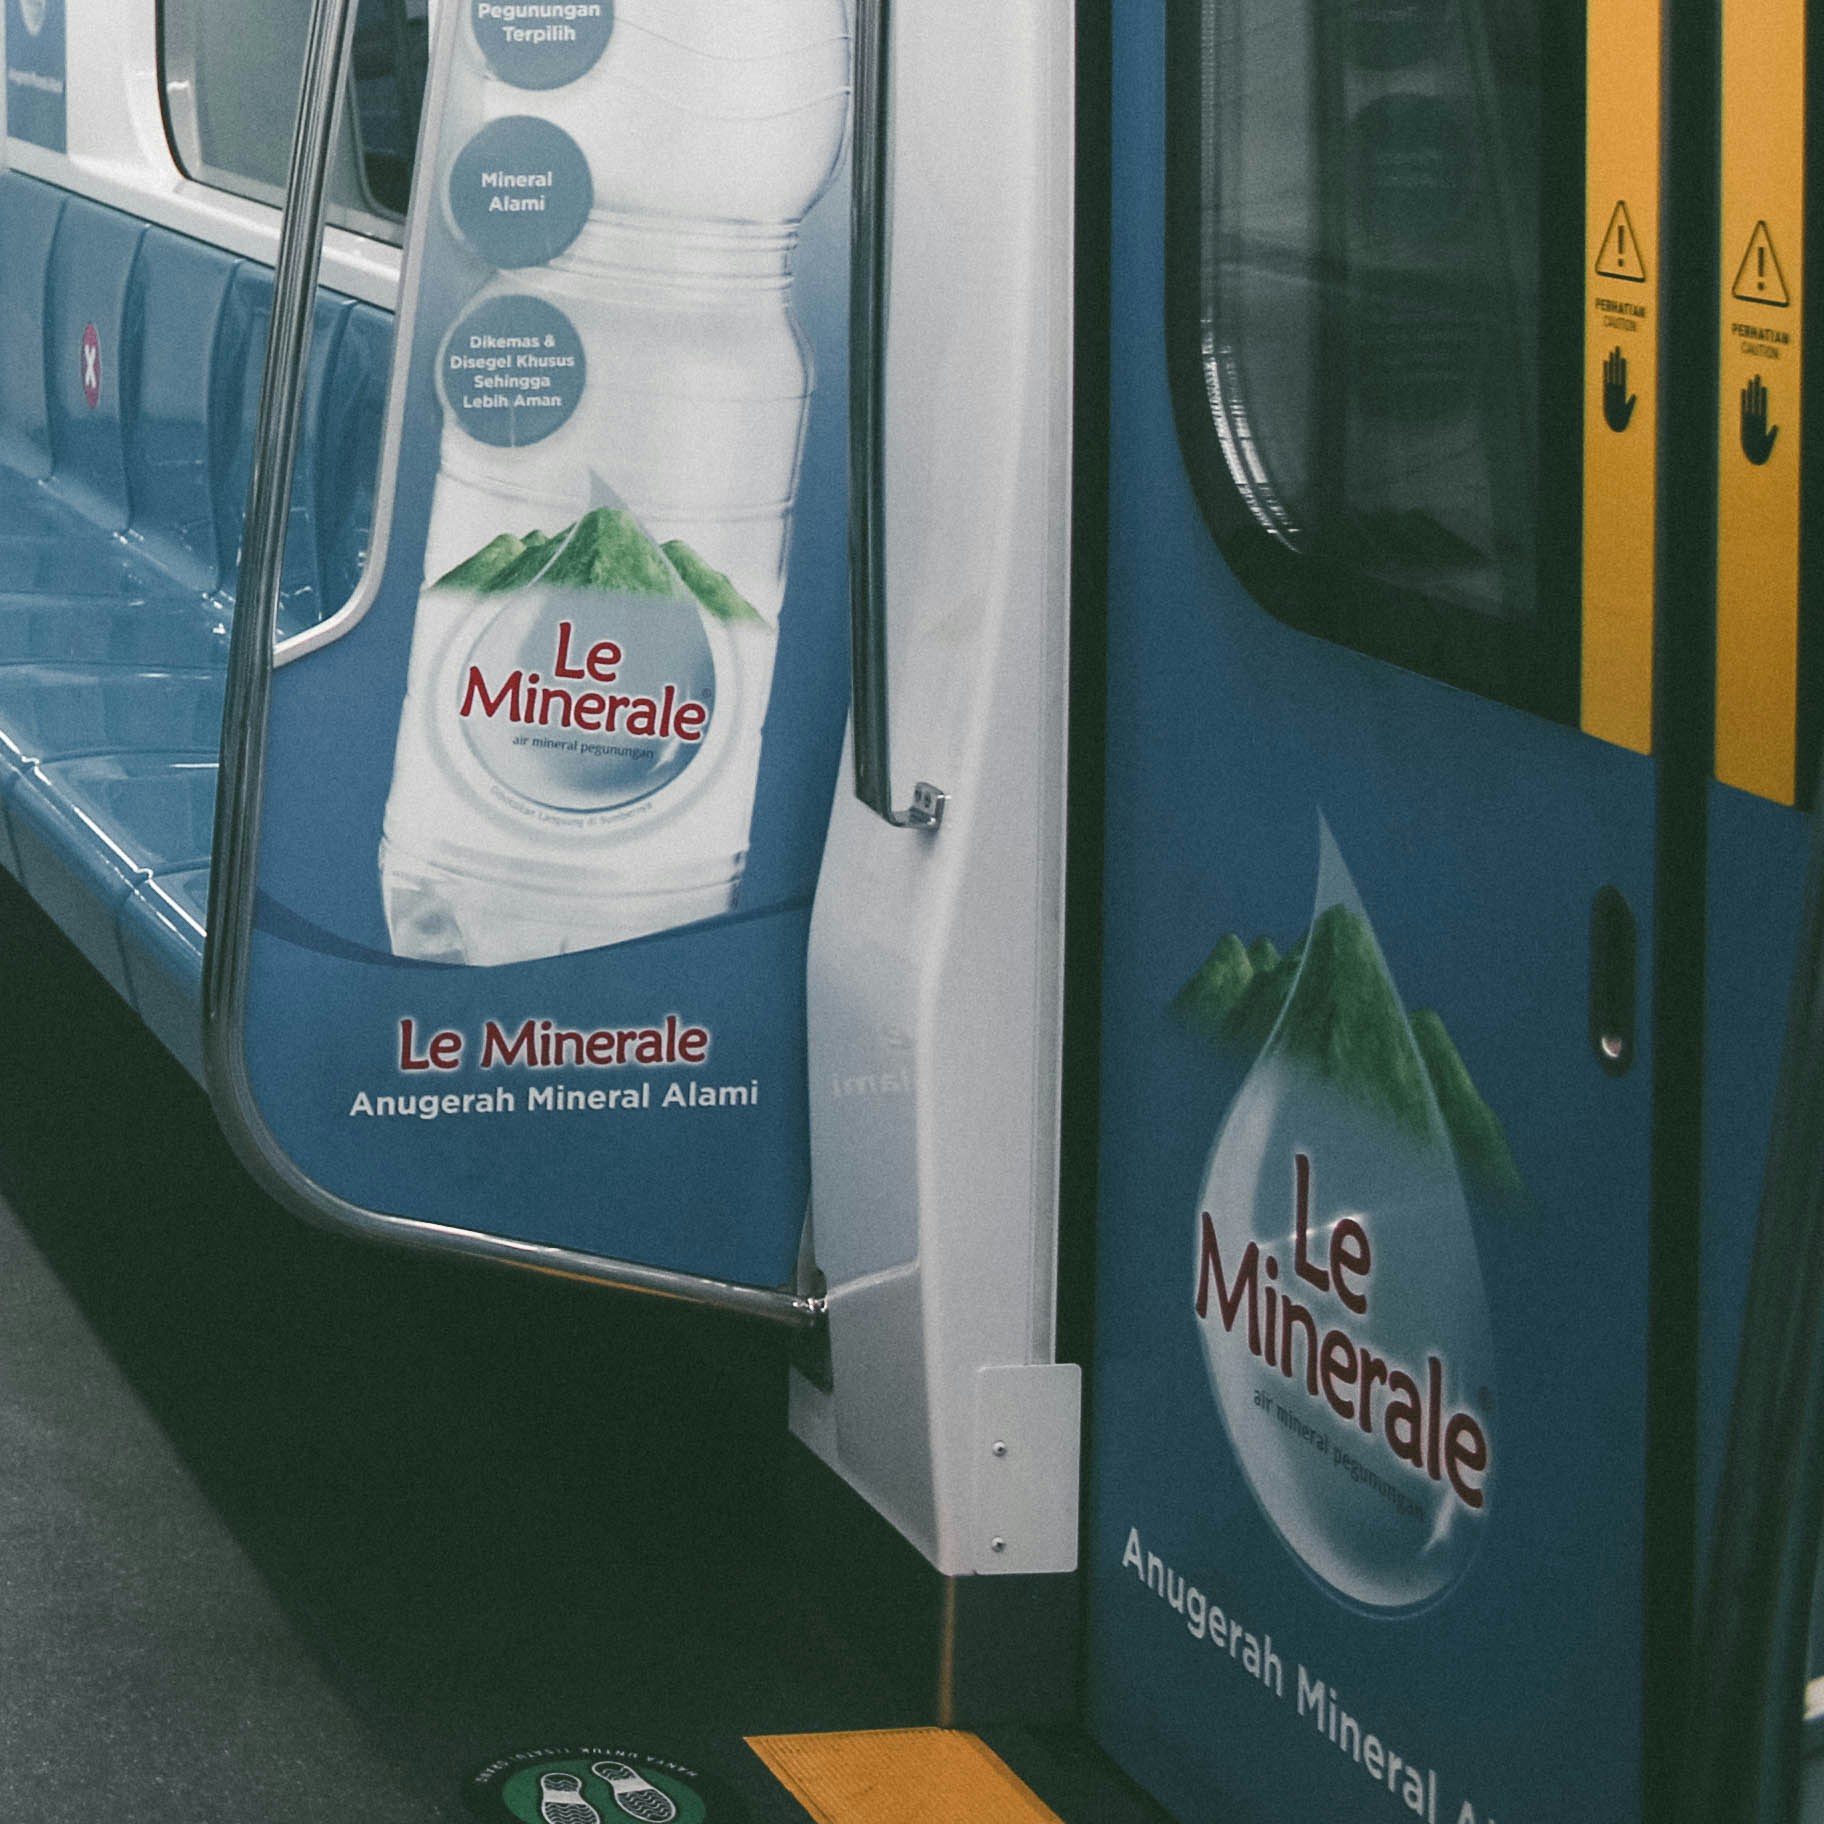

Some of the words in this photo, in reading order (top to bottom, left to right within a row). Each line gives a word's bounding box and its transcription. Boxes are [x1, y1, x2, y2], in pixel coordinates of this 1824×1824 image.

[479, 3, 600, 22] Pegunungan
[502, 26, 576, 44] Terpilih
[482, 171, 552, 187] Mineral
[489, 195, 545, 212] Alami
[1595, 298, 1646, 319] PERHATIAN
[470, 335, 540, 349] Dikemas
[543, 335, 555, 348] &
[1731, 323, 1791, 345] PERHATIAN
[450, 355, 512, 371] Disegel
[516, 355, 575, 368] Khusus
[474, 374, 550, 390] Sehingga
[463, 395, 508, 409] Lebih
[513, 394, 562, 407] Aman
[554, 622, 622, 682] Le
[459, 665, 707, 741] Minerale
[512, 736, 529, 746] air
[532, 737, 578, 752] mineral
[580, 743, 654, 760] pegunungan
[400, 1018, 463, 1070] Le
[481, 1015, 708, 1068] Minerale
[350, 1086, 514, 1120] Anugerah
[527, 1083, 650, 1111] Mineral
[661, 1080, 758, 1108] Alami
[1294, 1153, 1372, 1315] Le
[1196, 1211, 1487, 1510] Minerale
[1253, 1387, 1274, 1412] air
[1275, 1401, 1329, 1455] mineral
[1333, 1443, 1426, 1523] pegunungan
[1122, 1527, 1283, 1697] Anugerah
[1296, 1663, 1438, 1824] Mineral
